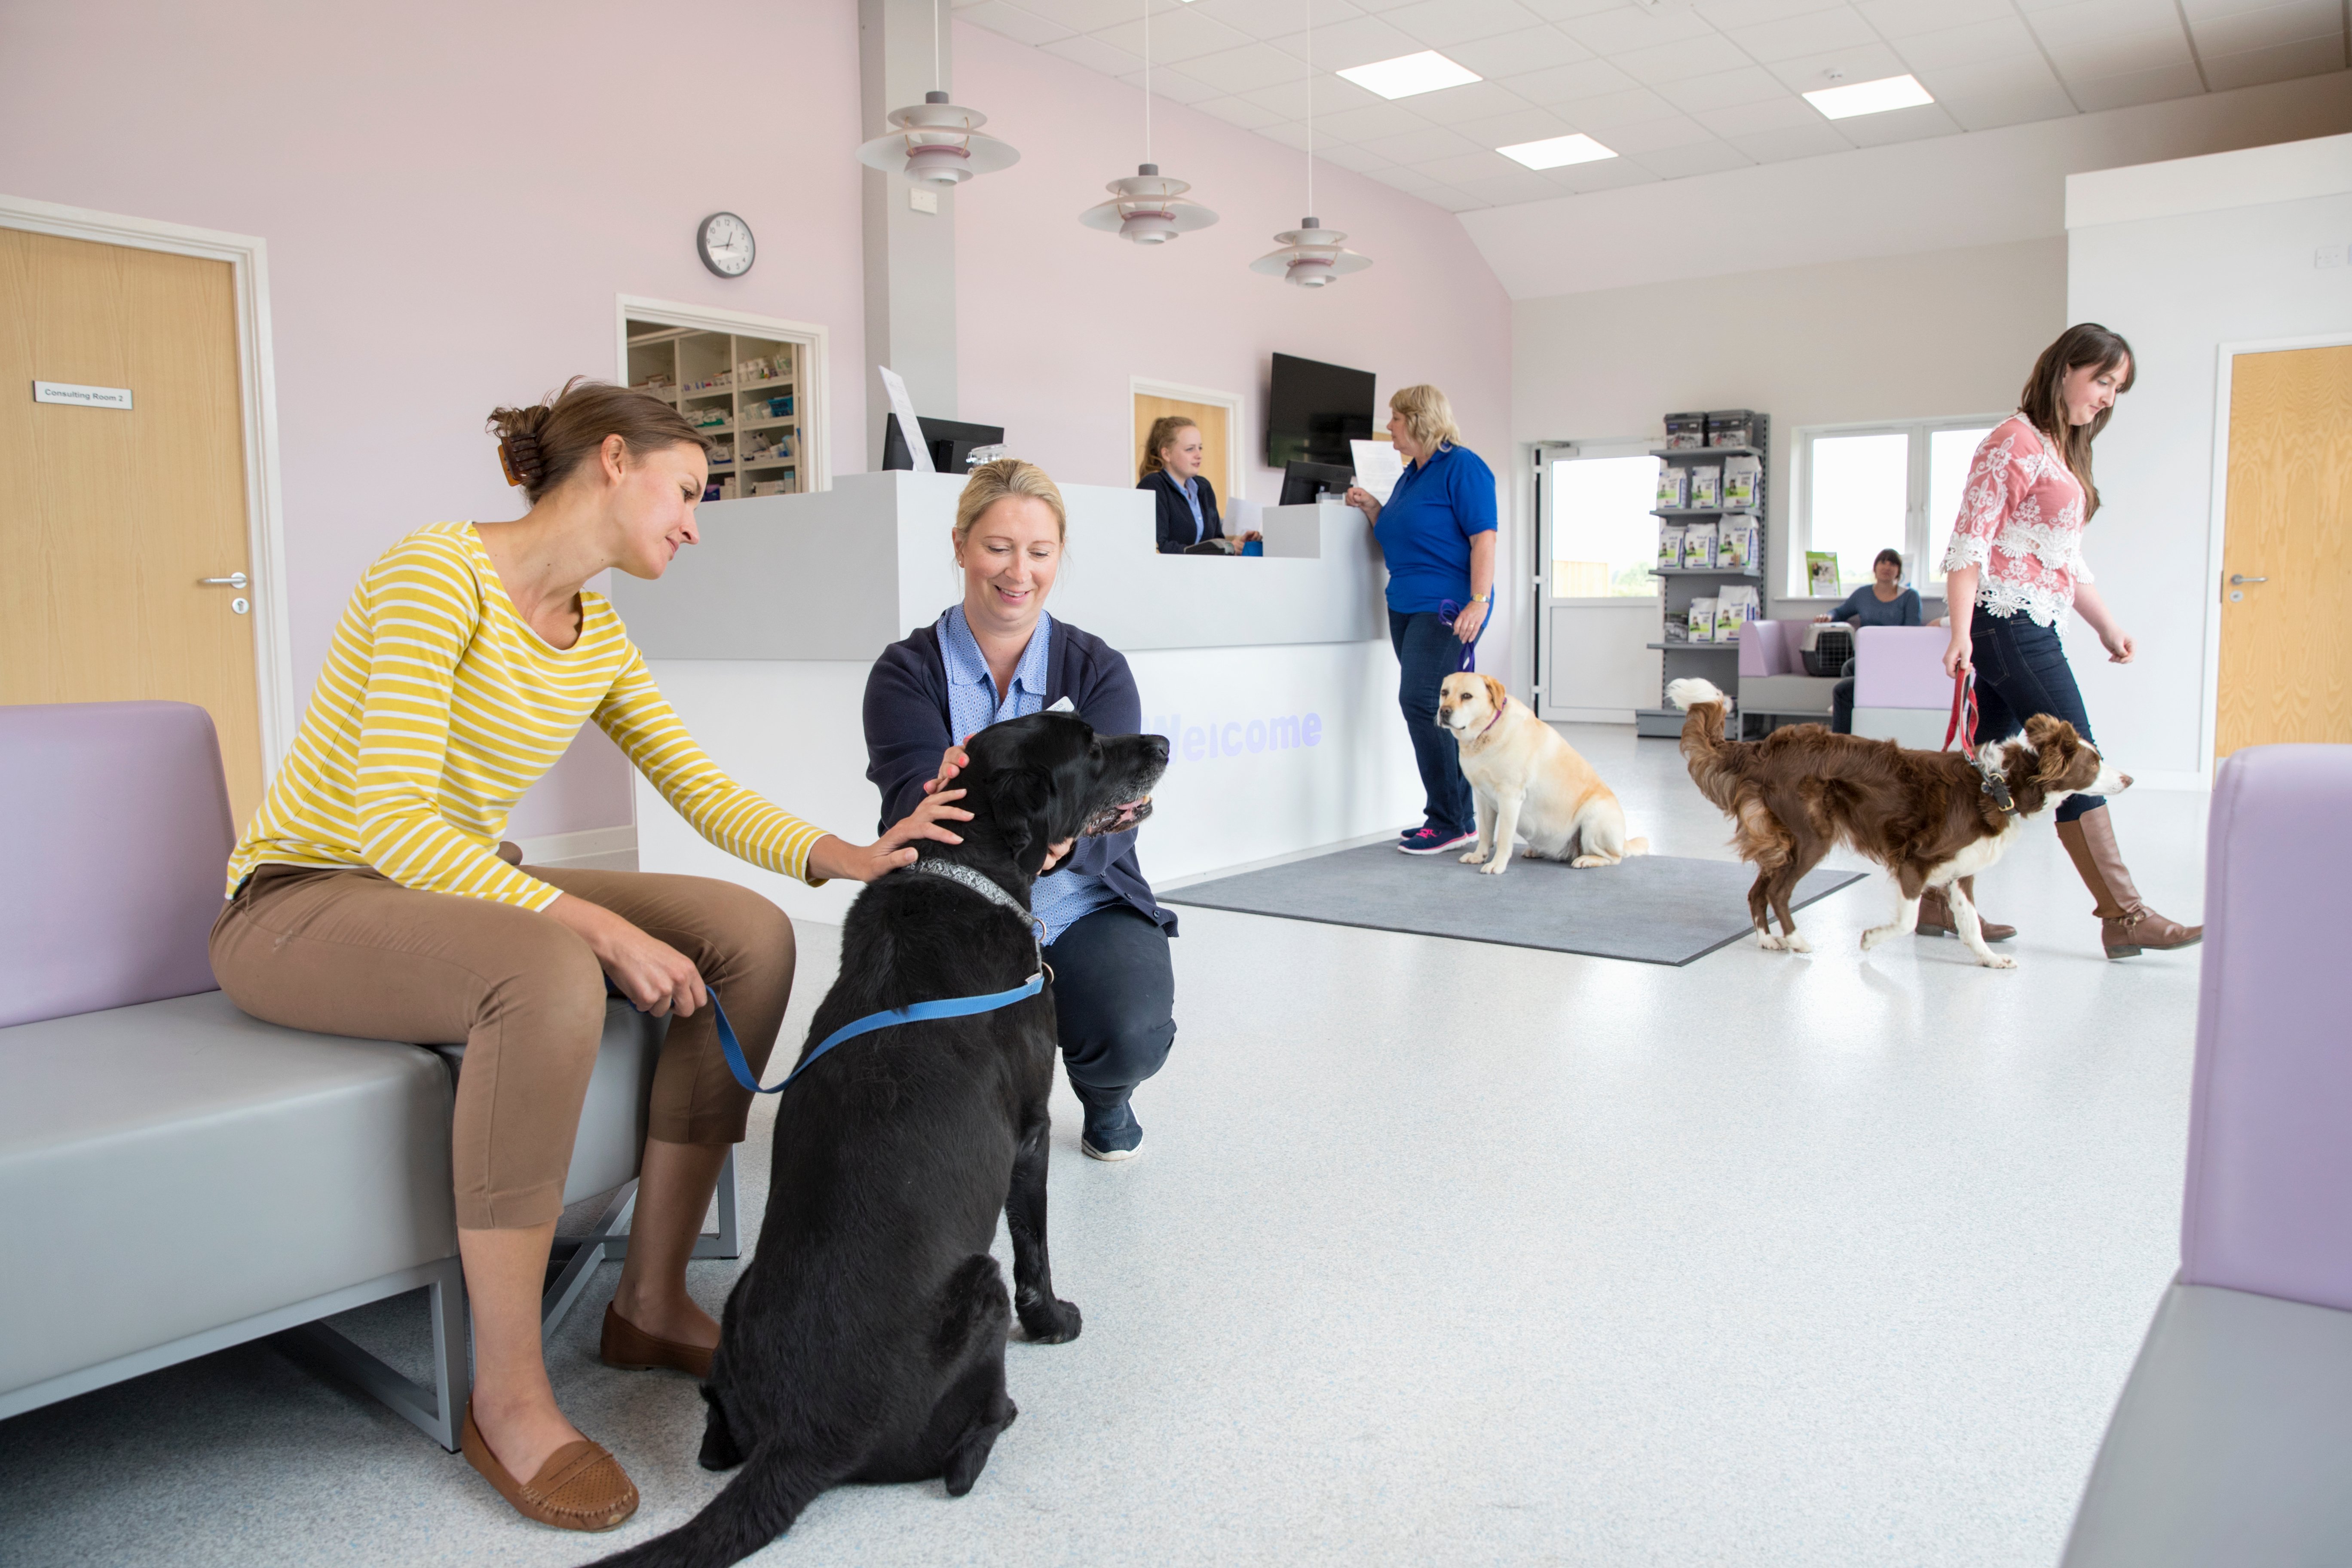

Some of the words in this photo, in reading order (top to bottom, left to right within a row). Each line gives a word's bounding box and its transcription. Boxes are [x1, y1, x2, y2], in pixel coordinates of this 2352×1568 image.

[45, 389, 90, 401] Consulting
[93, 393, 116, 401] Room
[1052, 703, 1063, 711] ONES
[1141, 713, 1322, 765] Welcome
